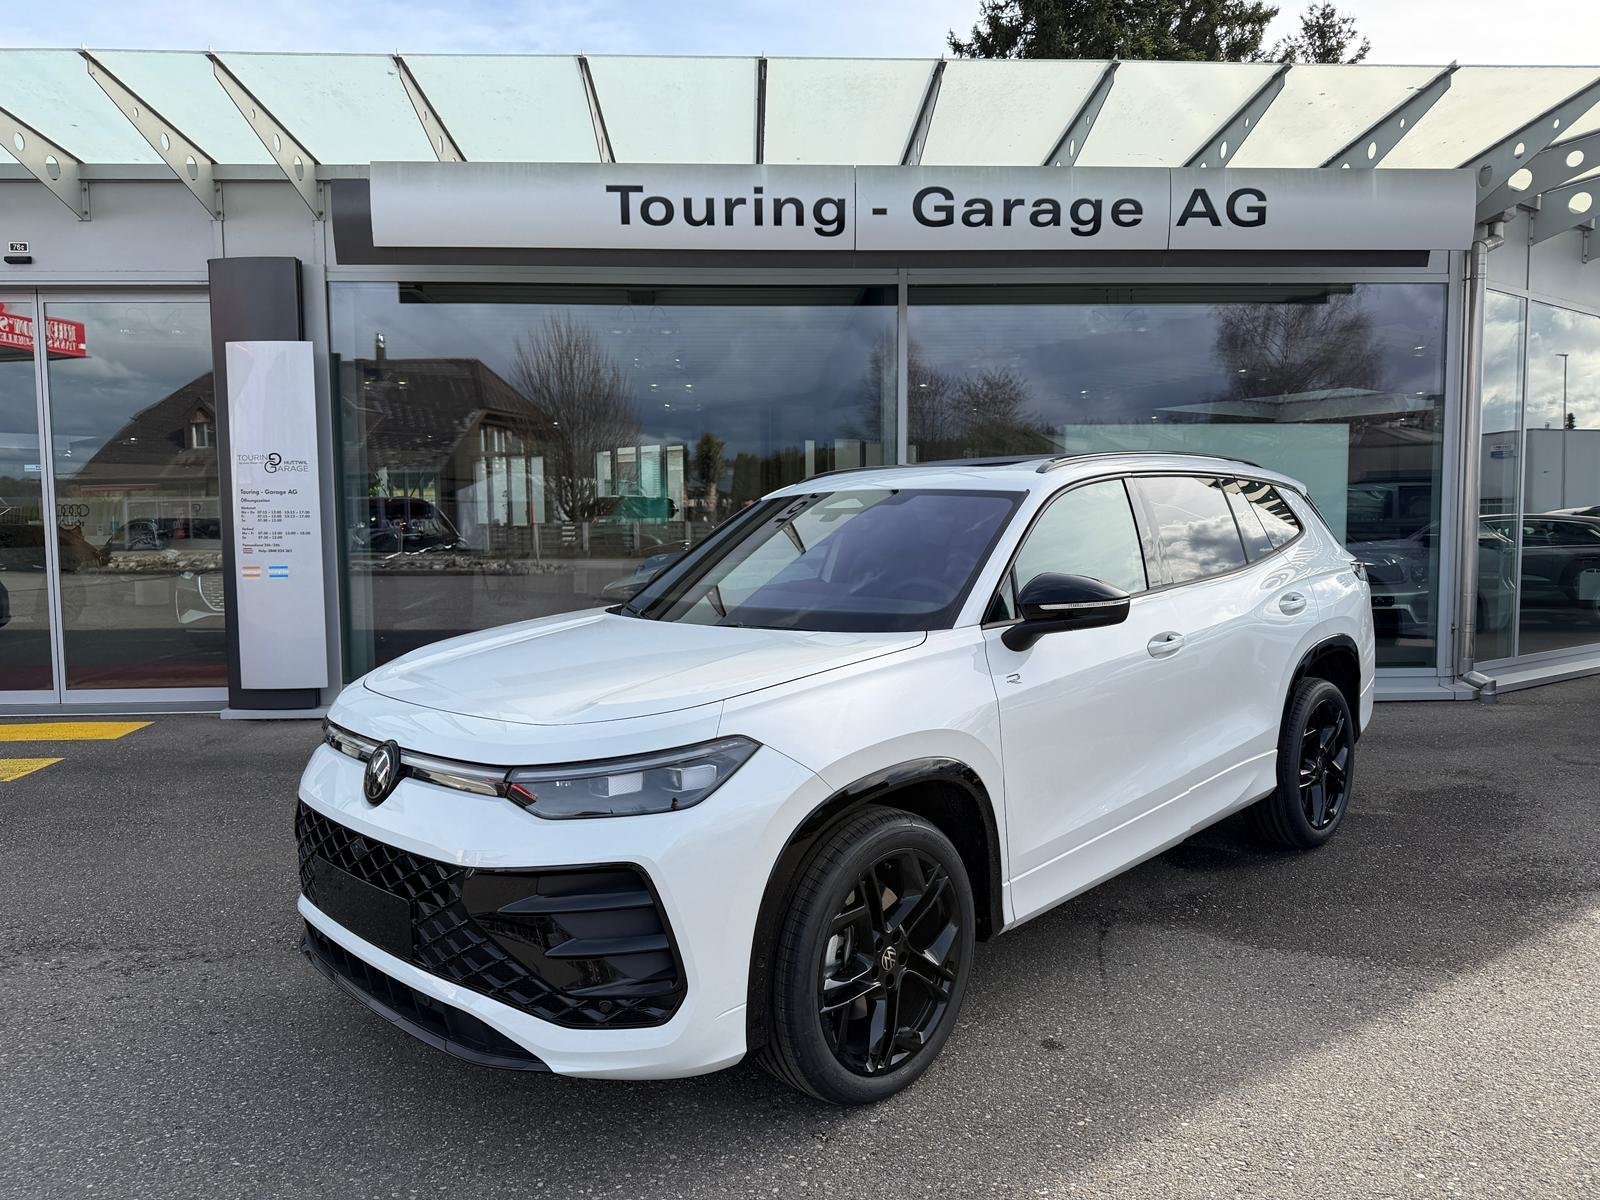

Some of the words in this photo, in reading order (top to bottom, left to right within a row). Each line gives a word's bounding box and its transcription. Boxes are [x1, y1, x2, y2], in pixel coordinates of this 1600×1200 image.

[606, 186, 845, 238] Touring
[913, 187, 1142, 237] Garage
[1176, 187, 1267, 228] AG
